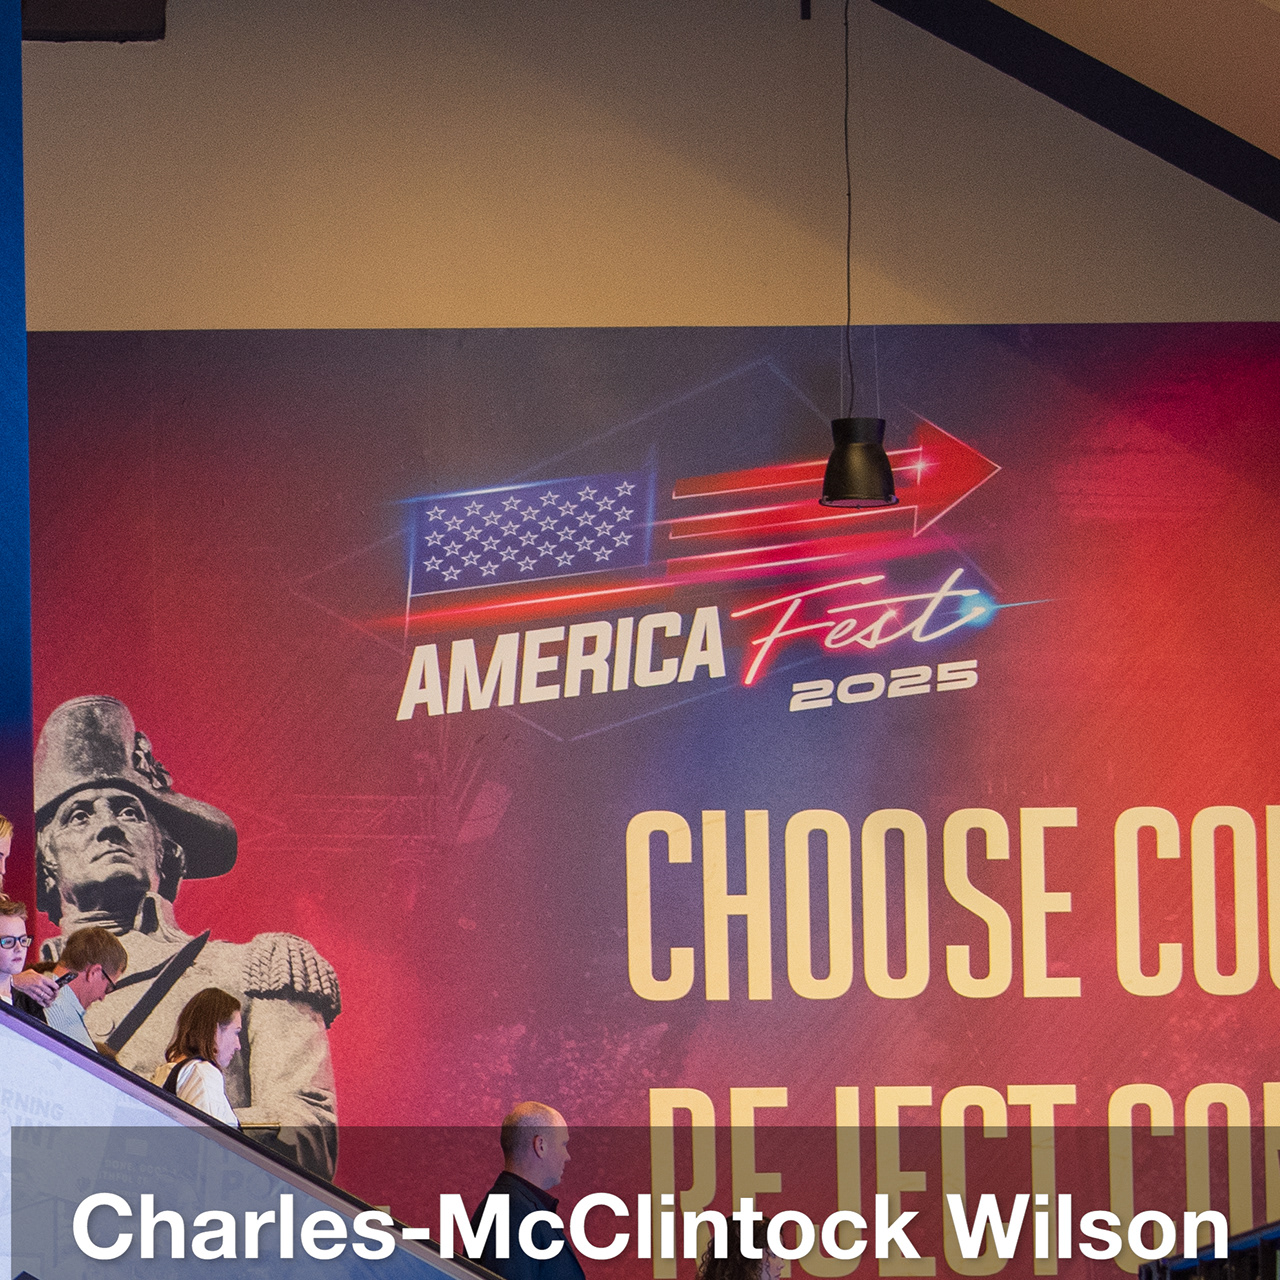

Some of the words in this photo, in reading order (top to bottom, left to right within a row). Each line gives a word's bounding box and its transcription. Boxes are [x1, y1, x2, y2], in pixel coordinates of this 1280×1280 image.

[396, 606, 727, 721] AMERICA
[731, 567, 987, 686] Fest
[789, 659, 980, 712] 2025
[625, 806, 1082, 1001] CHOOSE
[1113, 805, 1280, 998] CO
[648, 1083, 1077, 1280] REJECT
